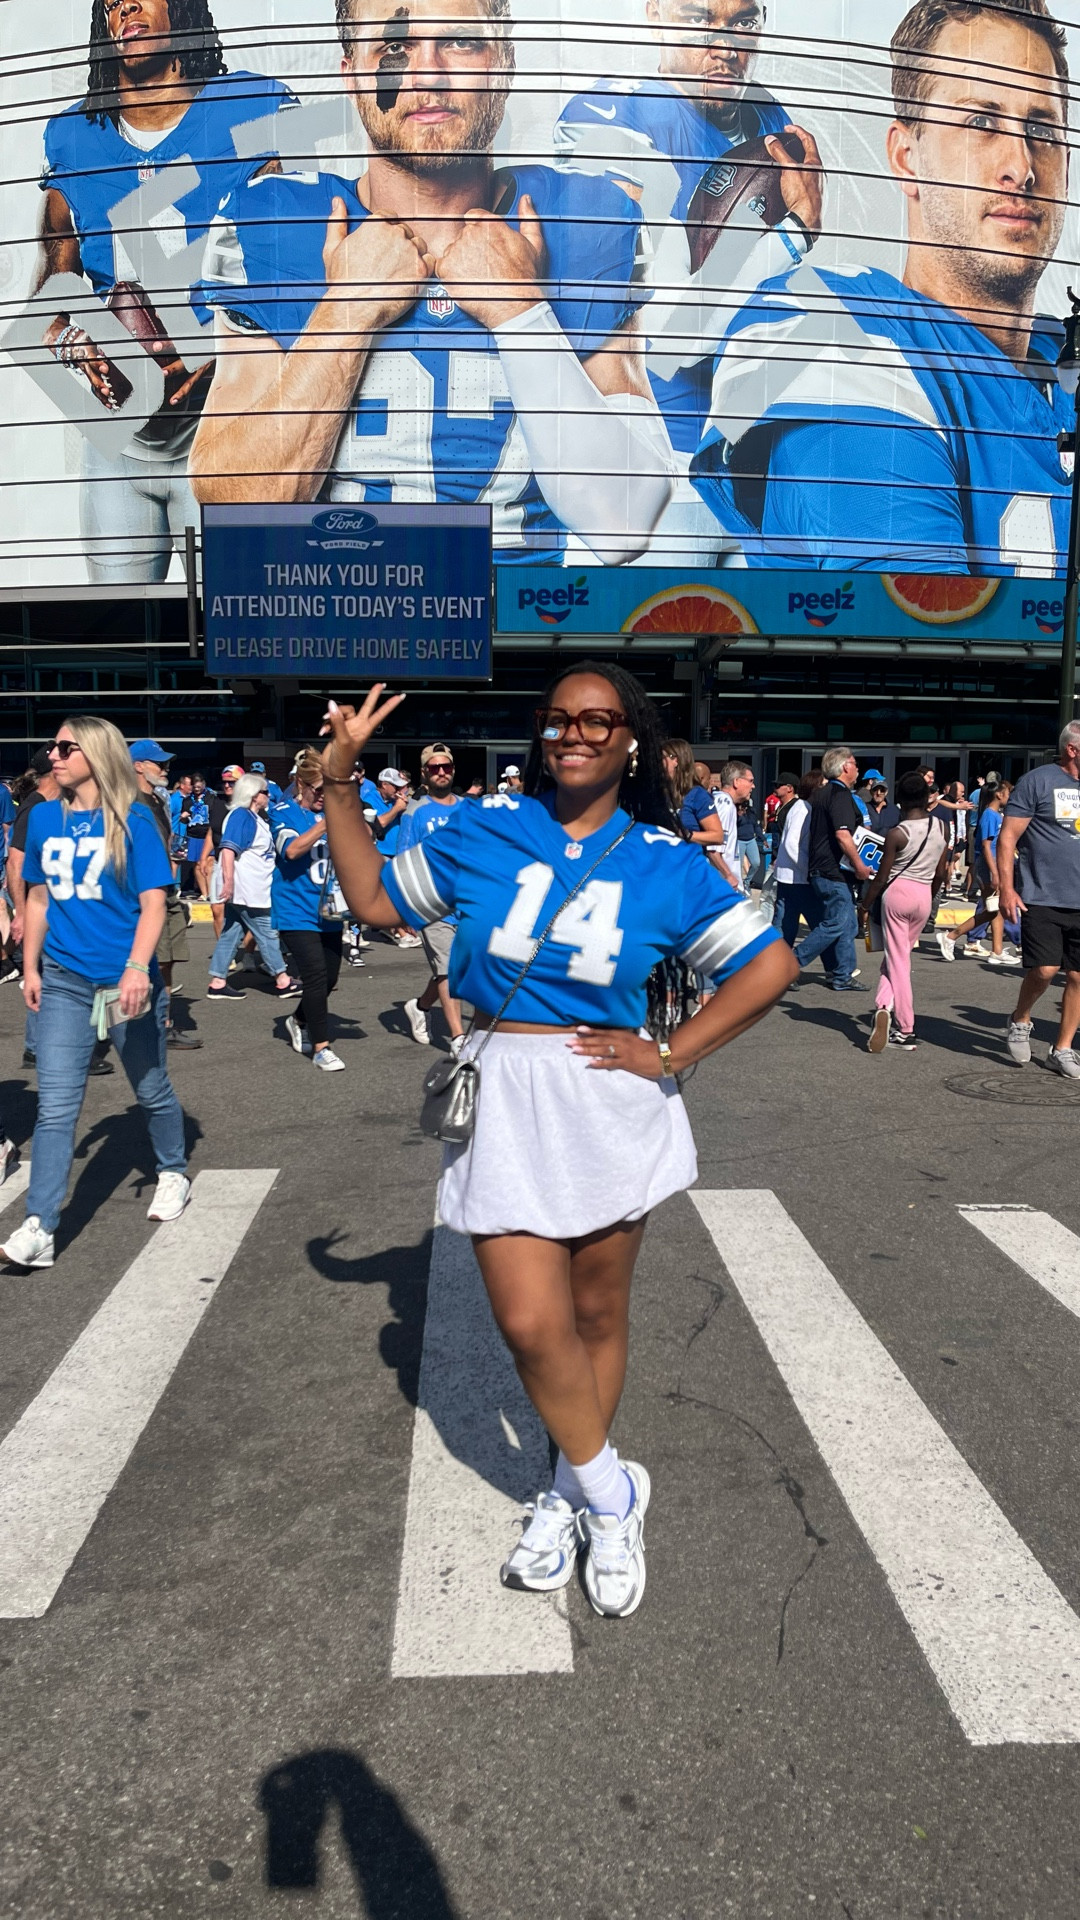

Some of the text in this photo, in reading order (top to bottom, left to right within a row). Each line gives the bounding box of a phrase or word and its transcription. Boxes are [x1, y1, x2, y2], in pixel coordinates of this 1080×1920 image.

[709, 162, 734, 193] NFL
[431, 299, 451, 312] NFL
[326, 512, 364, 530] Ford
[263, 564, 424, 587] THANK YOU FOR
[211, 595, 486, 619] ATTENDING TODAY'S EVENT
[518, 583, 590, 610] peelz
[788, 587, 855, 613] peelz
[215, 637, 483, 660] PLEASE DRIVE HOME SAFELY
[41, 836, 106, 901] 97
[487, 861, 624, 987] 14
